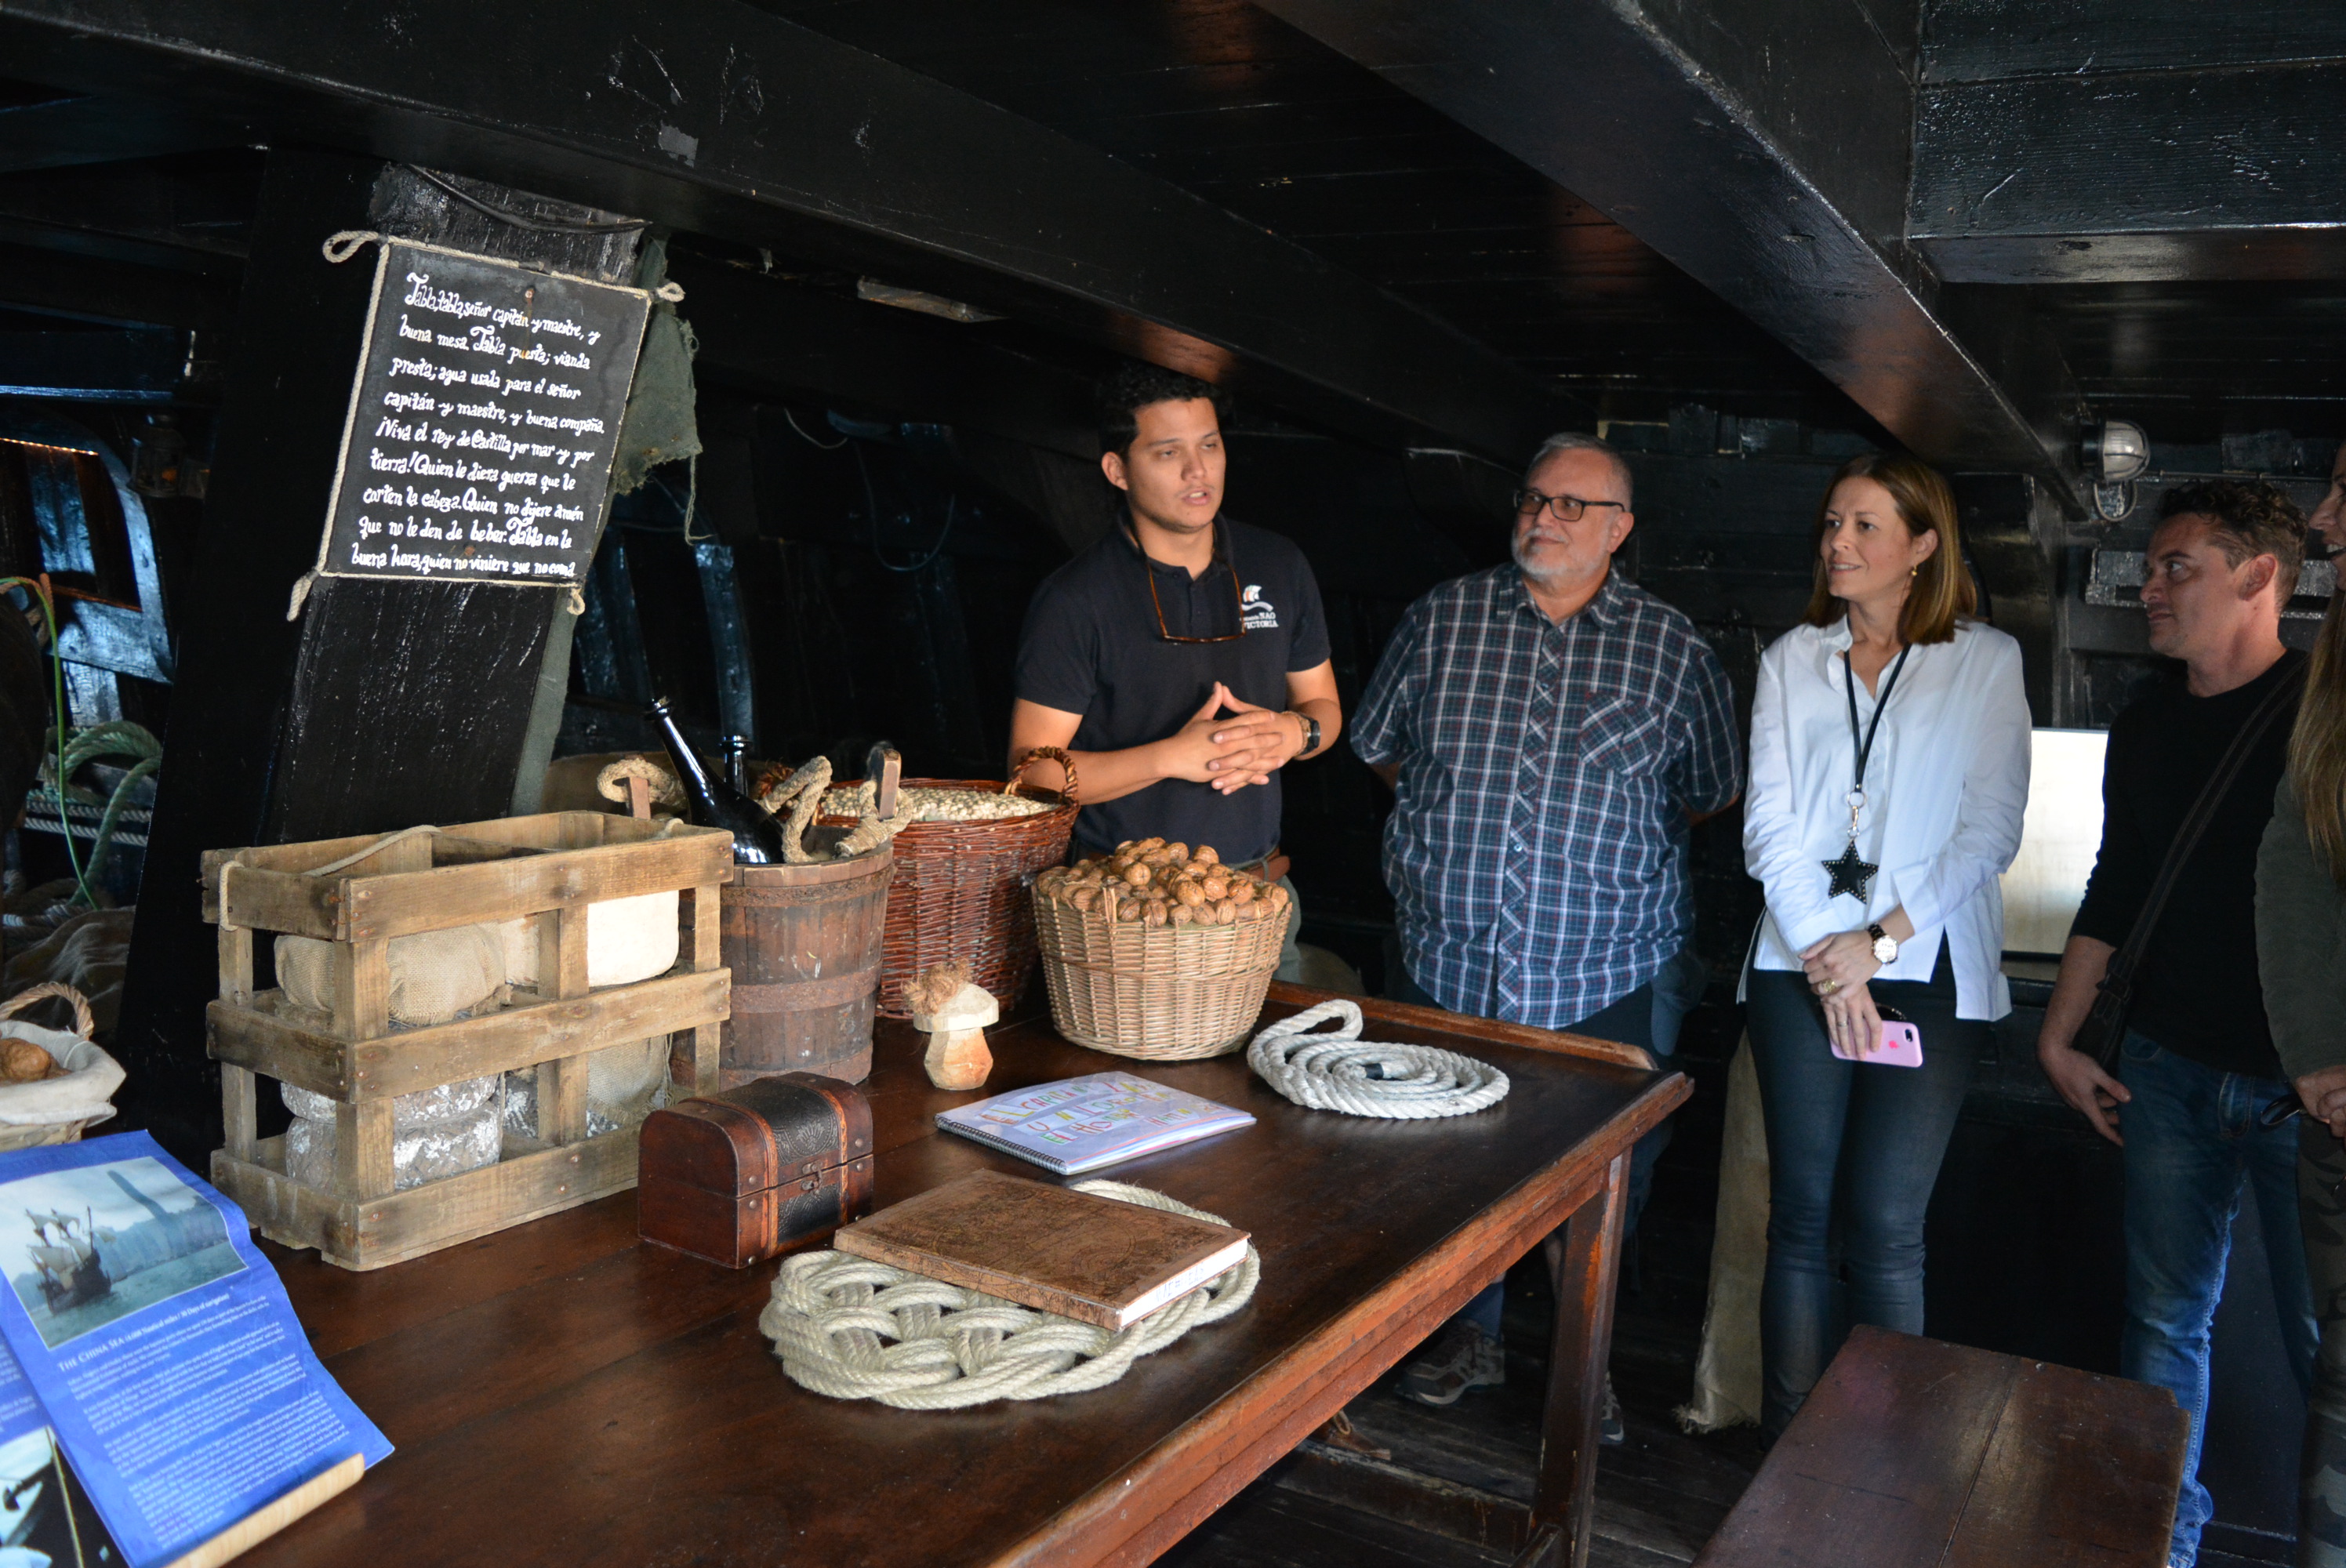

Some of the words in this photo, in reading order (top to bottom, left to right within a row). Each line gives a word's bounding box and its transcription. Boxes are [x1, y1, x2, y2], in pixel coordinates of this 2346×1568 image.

[399, 314, 432, 343] buena
[470, 325, 506, 355] Tabla
[507, 343, 551, 365] puesta;
[554, 350, 590, 369] vianda
[463, 302, 492, 317] señor
[492, 308, 529, 328] capitán
[531, 319, 542, 333] y
[542, 319, 584, 340] maestre,
[588, 331, 601, 345] y
[389, 358, 438, 380] presta;
[438, 366, 467, 386] agua
[470, 369, 500, 388] usada
[502, 379, 532, 396] para
[534, 378, 547, 394] el
[547, 383, 581, 400] señor
[383, 392, 434, 412] capitán
[438, 402, 454, 417] y
[457, 401, 507, 423] maestre,
[510, 413, 523, 426] y
[526, 409, 558, 429] buena
[560, 417, 605, 437] compaña.
[414, 421, 427, 441] el
[431, 428, 456, 449] rey
[456, 430, 470, 446] de
[471, 429, 511, 453] Castilla
[509, 442, 529, 460] por
[531, 444, 555, 457] mar
[556, 448, 571, 465] y
[570, 452, 595, 468] por
[414, 454, 454, 477] Quien
[455, 459, 467, 478] le
[467, 462, 499, 481] diera
[498, 471, 538, 492] guerra
[540, 475, 560, 495] que
[562, 473, 576, 491] le
[406, 485, 419, 507] la
[462, 487, 498, 514] Quien
[503, 502, 519, 514] no
[521, 497, 553, 521] dijere
[554, 504, 583, 521] amén
[358, 515, 382, 540] que
[389, 521, 404, 536] no
[406, 515, 419, 537] le
[419, 517, 442, 540] den
[445, 520, 463, 540] de
[506, 516, 543, 547] Tabla
[544, 534, 559, 546] en
[560, 528, 572, 549] la
[351, 542, 387, 569] buena
[419, 553, 452, 575] quien
[453, 557, 469, 570] no
[469, 554, 510, 572] viniere
[511, 561, 531, 575] que
[534, 562, 548, 575] no
[549, 561, 576, 578] coma
[57, 1359, 78, 1372] THE
[79, 1344, 108, 1364] CHINA
